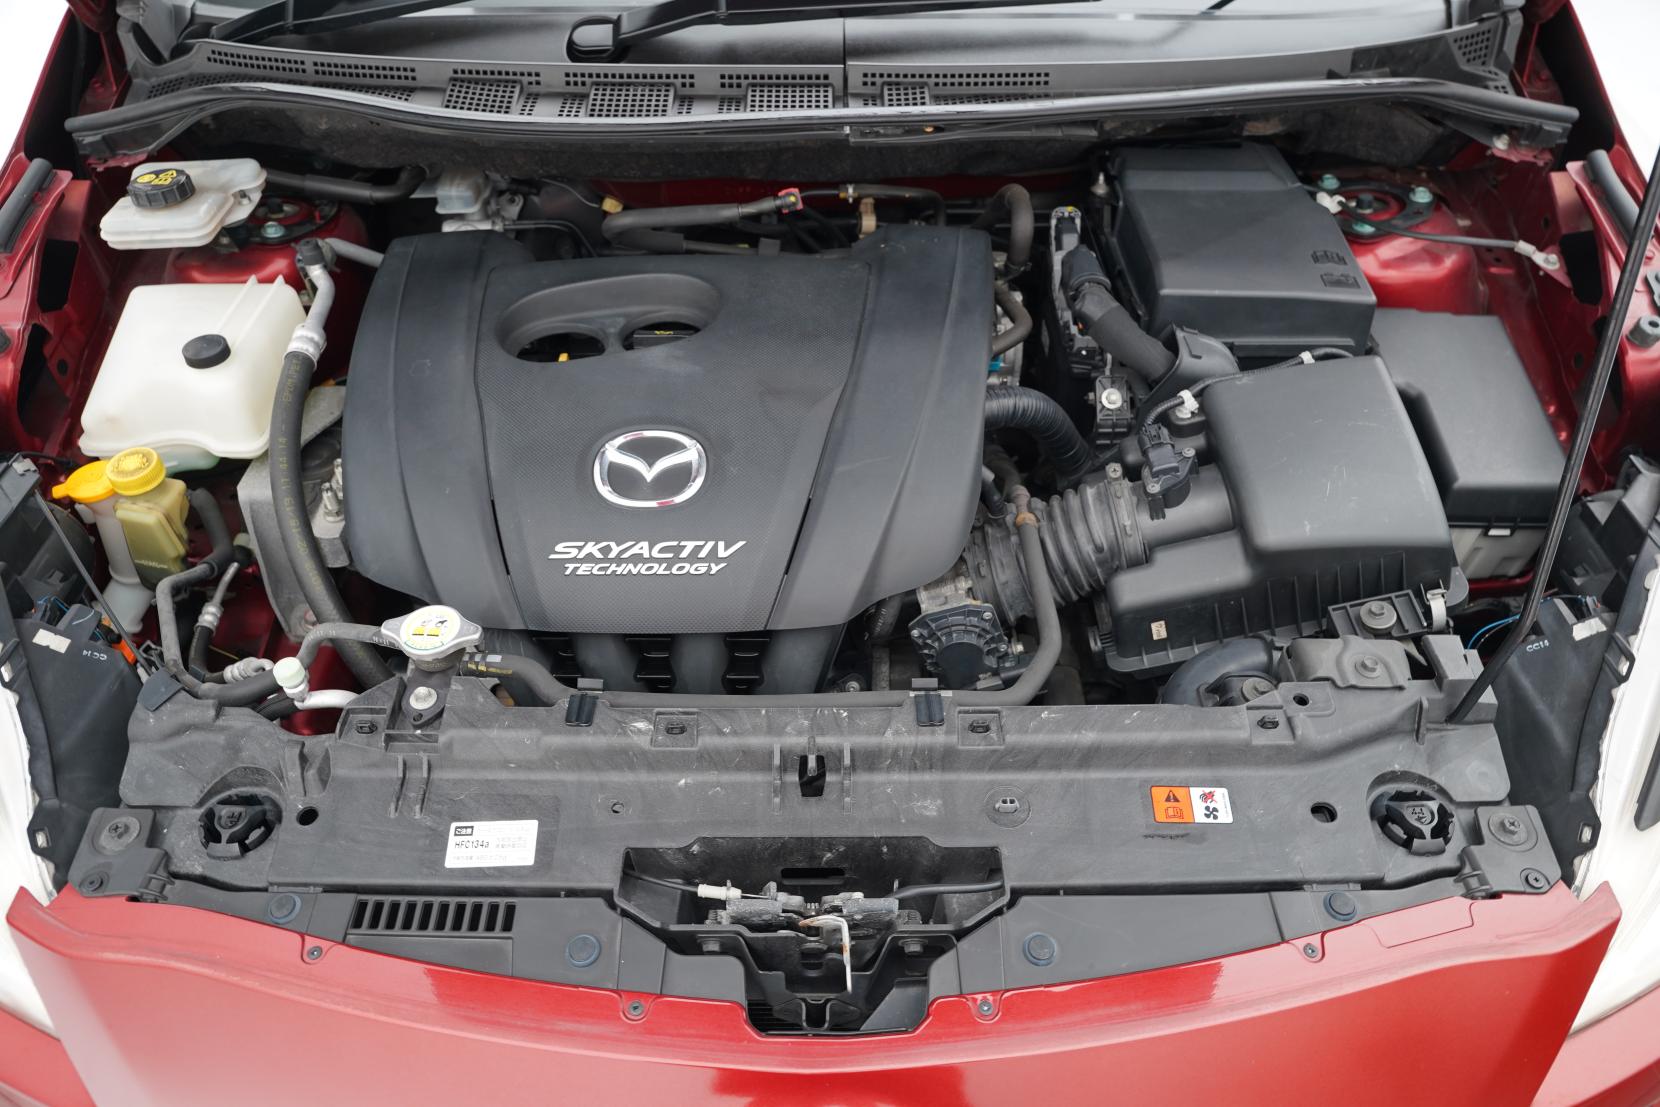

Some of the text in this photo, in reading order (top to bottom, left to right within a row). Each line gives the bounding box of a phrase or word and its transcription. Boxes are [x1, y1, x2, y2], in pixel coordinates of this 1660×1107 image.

[548, 540, 747, 559] SKYACTIV
[564, 562, 728, 576] TECHNOLOGY
[454, 839, 490, 849] HFC134a
